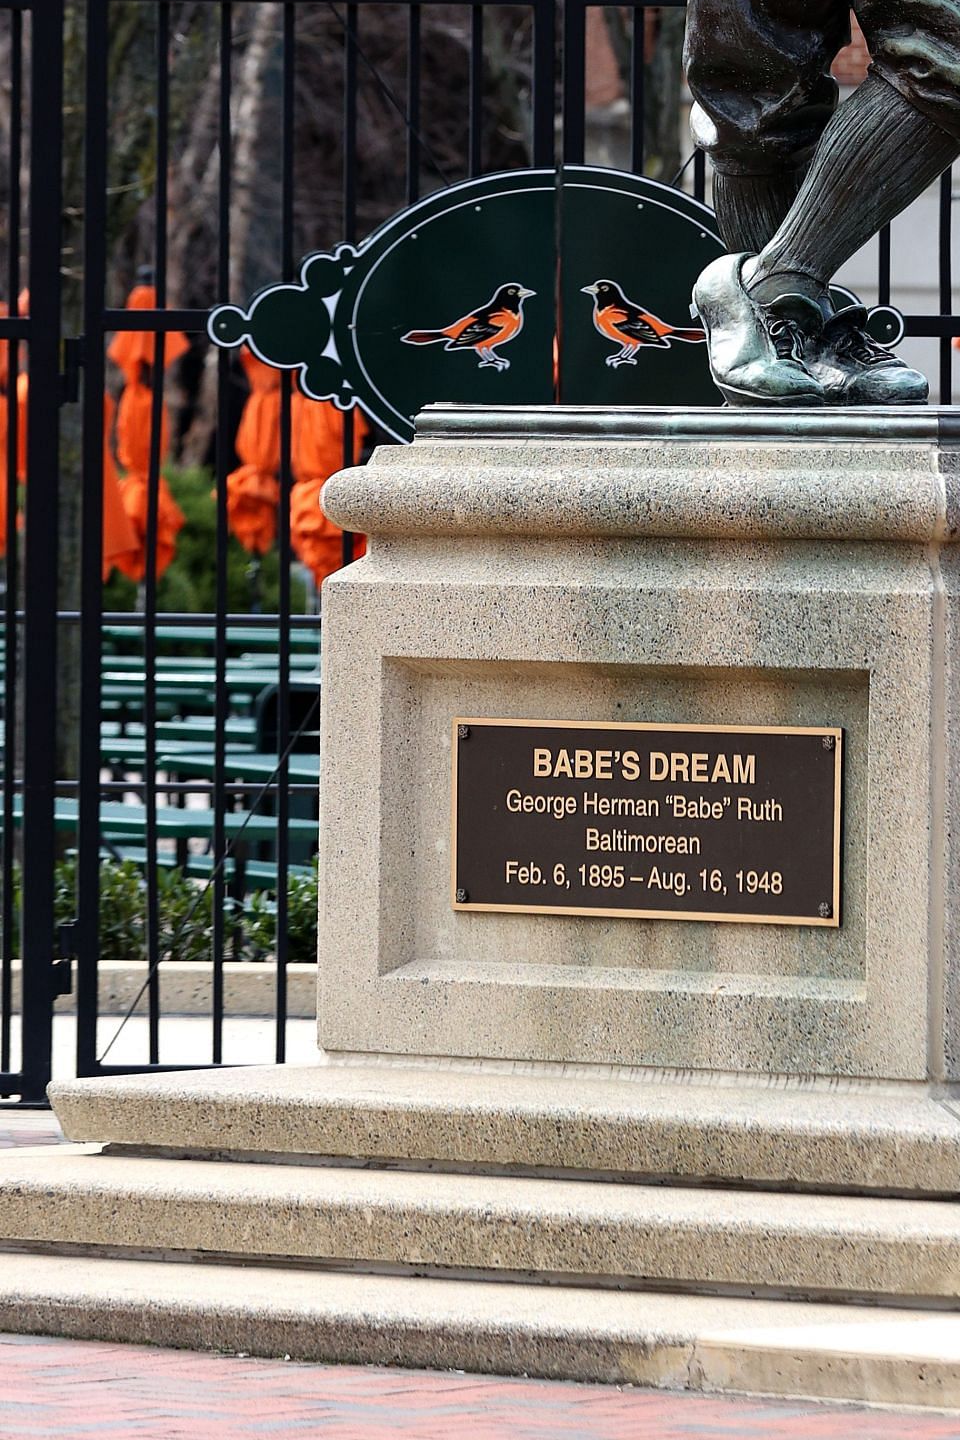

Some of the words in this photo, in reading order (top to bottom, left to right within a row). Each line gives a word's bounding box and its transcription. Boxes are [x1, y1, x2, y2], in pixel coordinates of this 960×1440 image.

[533, 747, 641, 781] BABE’S
[649, 751, 756, 785] DREAM
[506, 788, 577, 820] George
[583, 791, 659, 817] Herman
[665, 794, 731, 820] “Babe”
[737, 796, 783, 822] Ruth
[586, 827, 701, 855] Baltimorean
[505, 860, 547, 885] Feb.
[552, 862, 571, 890] 6,
[578, 863, 625, 888] 1895
[647, 865, 691, 897] Aug.
[699, 868, 727, 897] 16,
[735, 869, 783, 895] 1948
